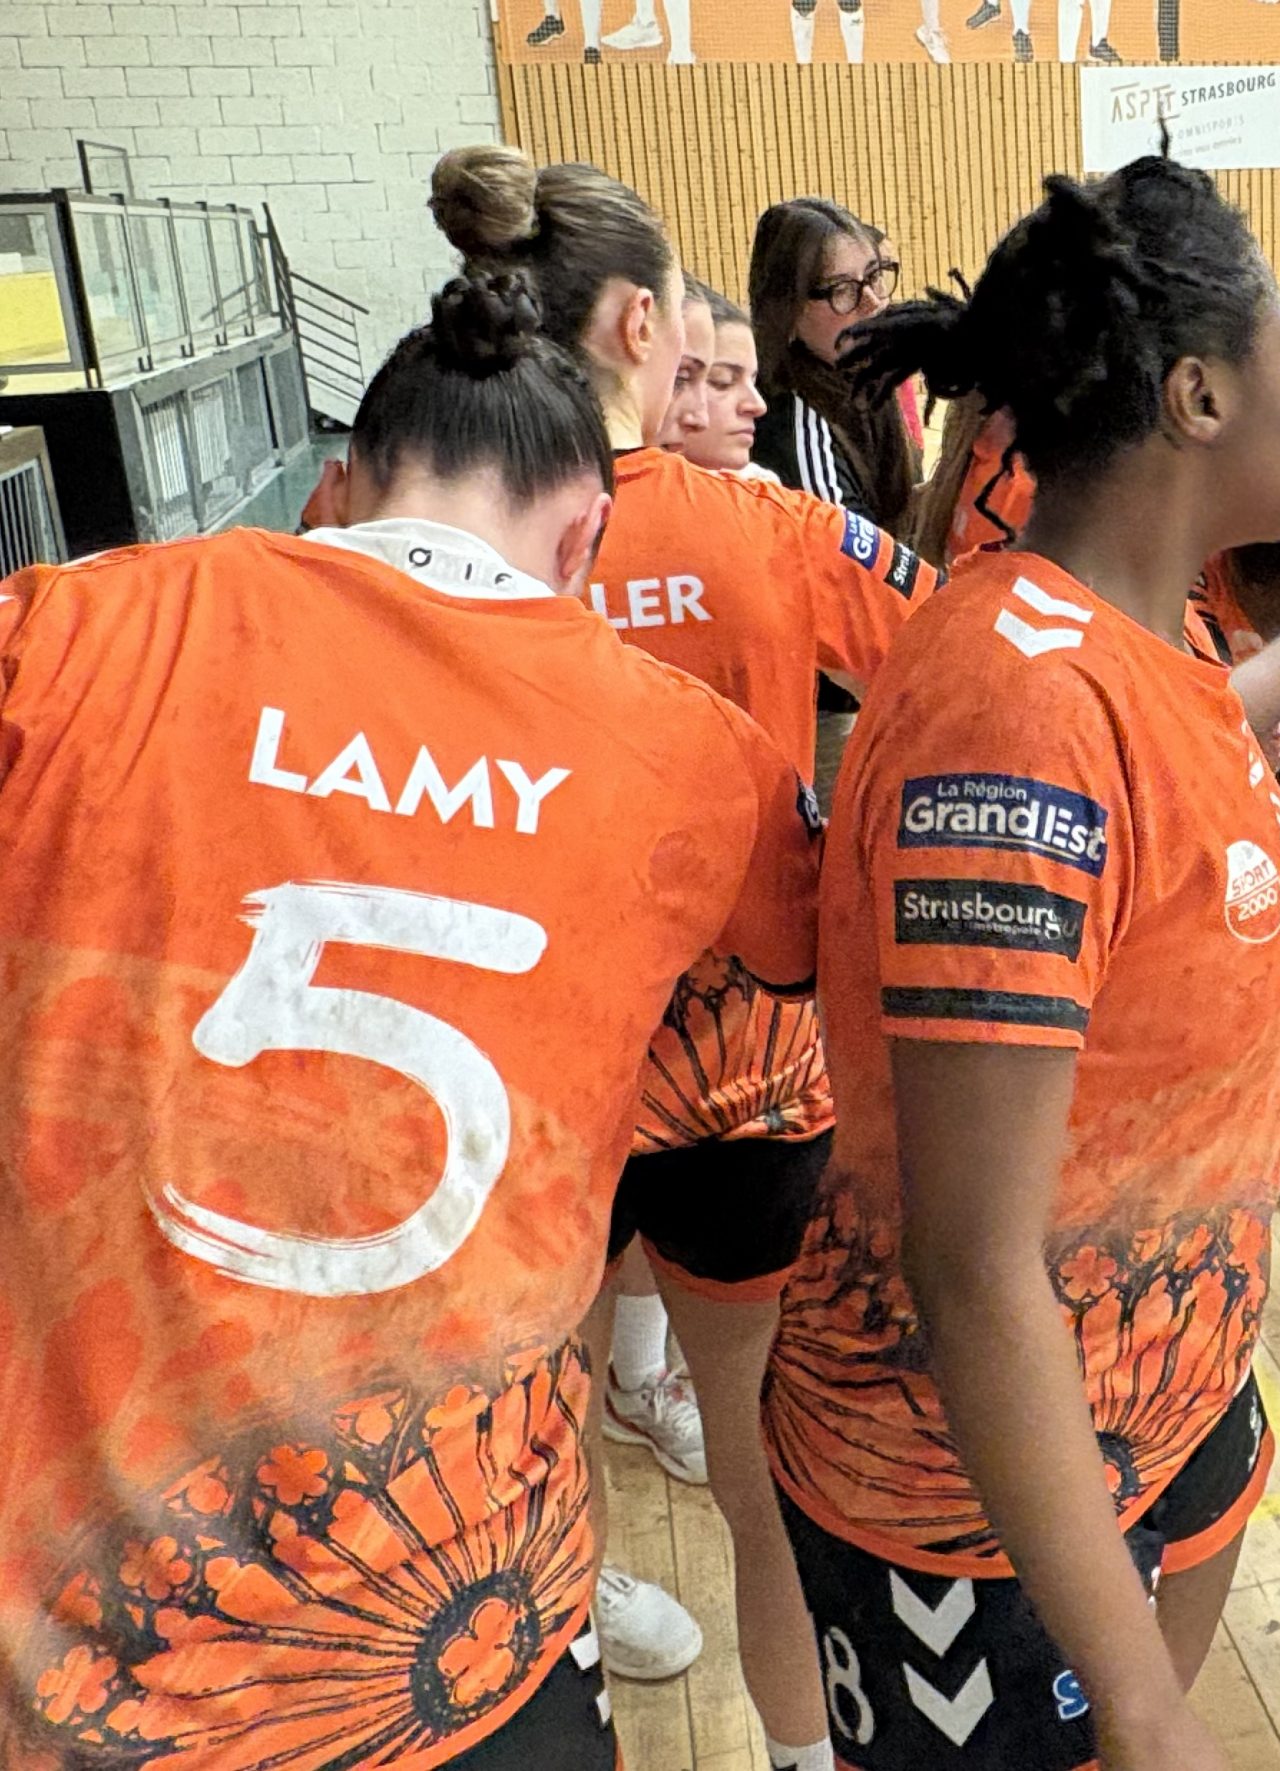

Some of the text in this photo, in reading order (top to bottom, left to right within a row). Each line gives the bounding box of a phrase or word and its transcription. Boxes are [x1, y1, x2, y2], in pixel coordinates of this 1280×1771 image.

[1181, 73, 1276, 106] STRASBOURG
[248, 706, 572, 834] LAMY
[937, 780, 1027, 800] La Région
[1238, 888, 1279, 922] 2000
[144, 879, 547, 1298] 5
[825, 1626, 875, 1746] 8
